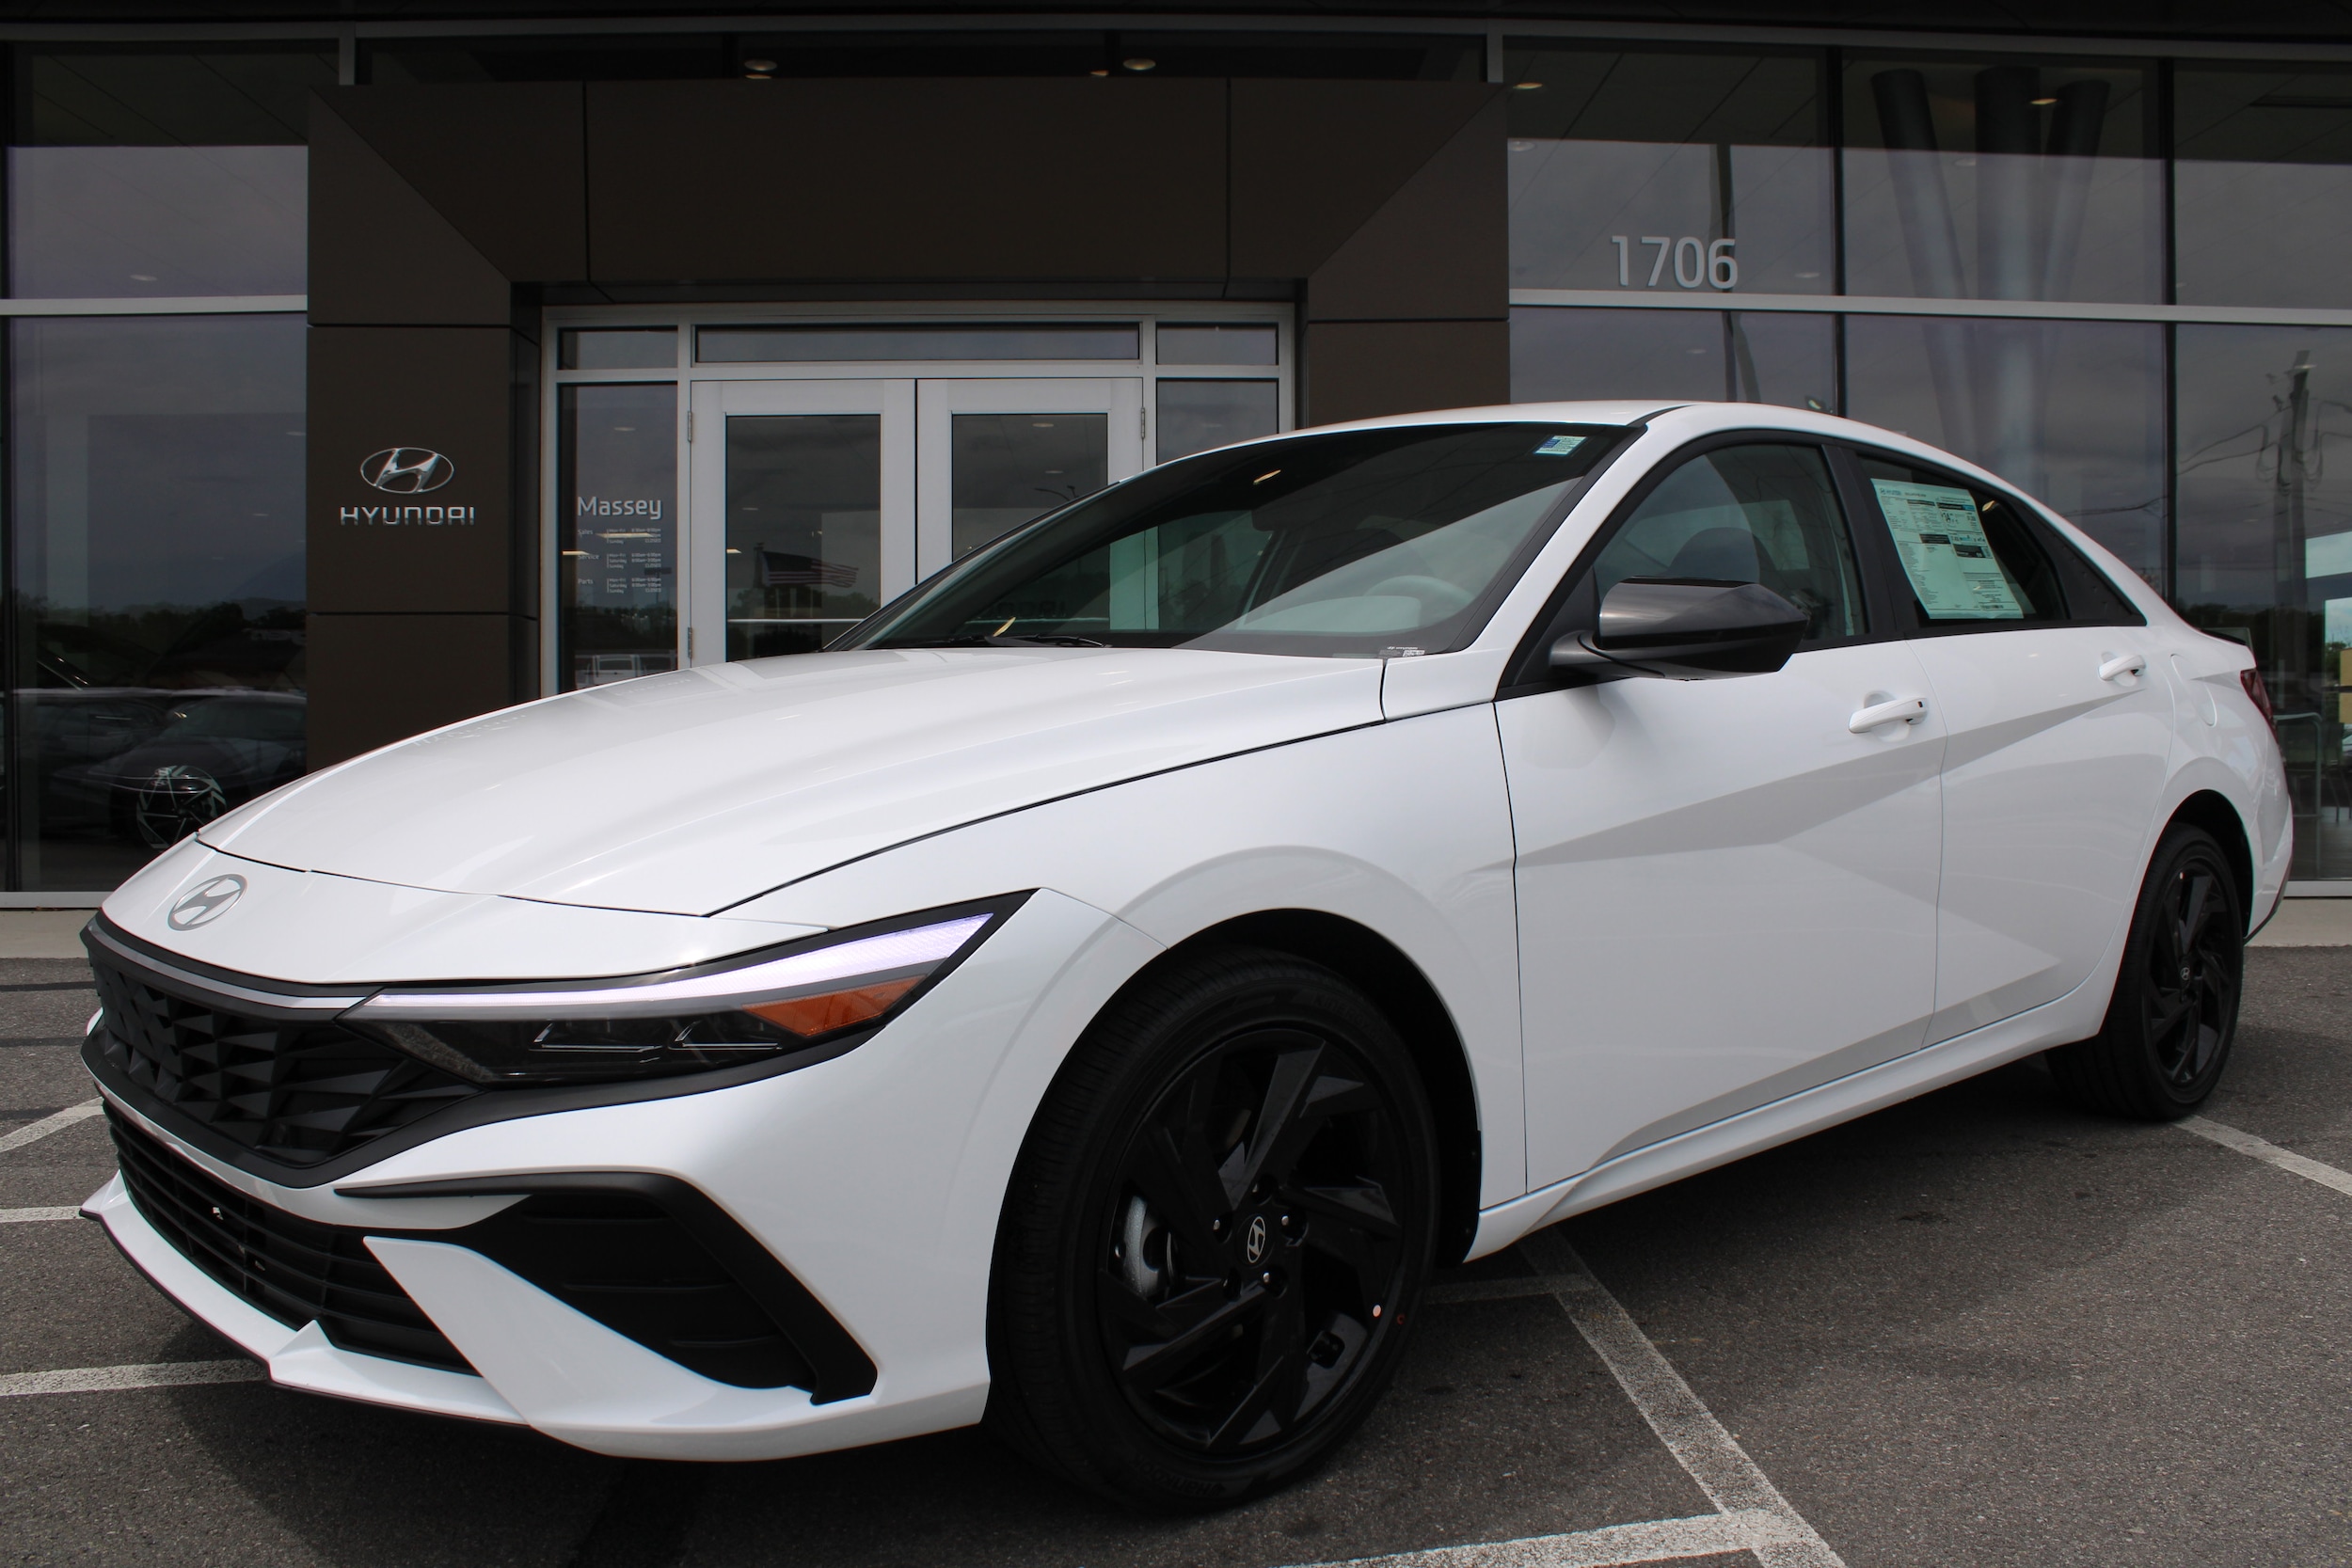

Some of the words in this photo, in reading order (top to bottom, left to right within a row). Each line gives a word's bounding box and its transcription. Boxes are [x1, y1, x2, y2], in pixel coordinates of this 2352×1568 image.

[1612, 235, 1738, 289] 1706
[340, 506, 475, 526] HYUNDAI
[578, 496, 661, 519] Massey
